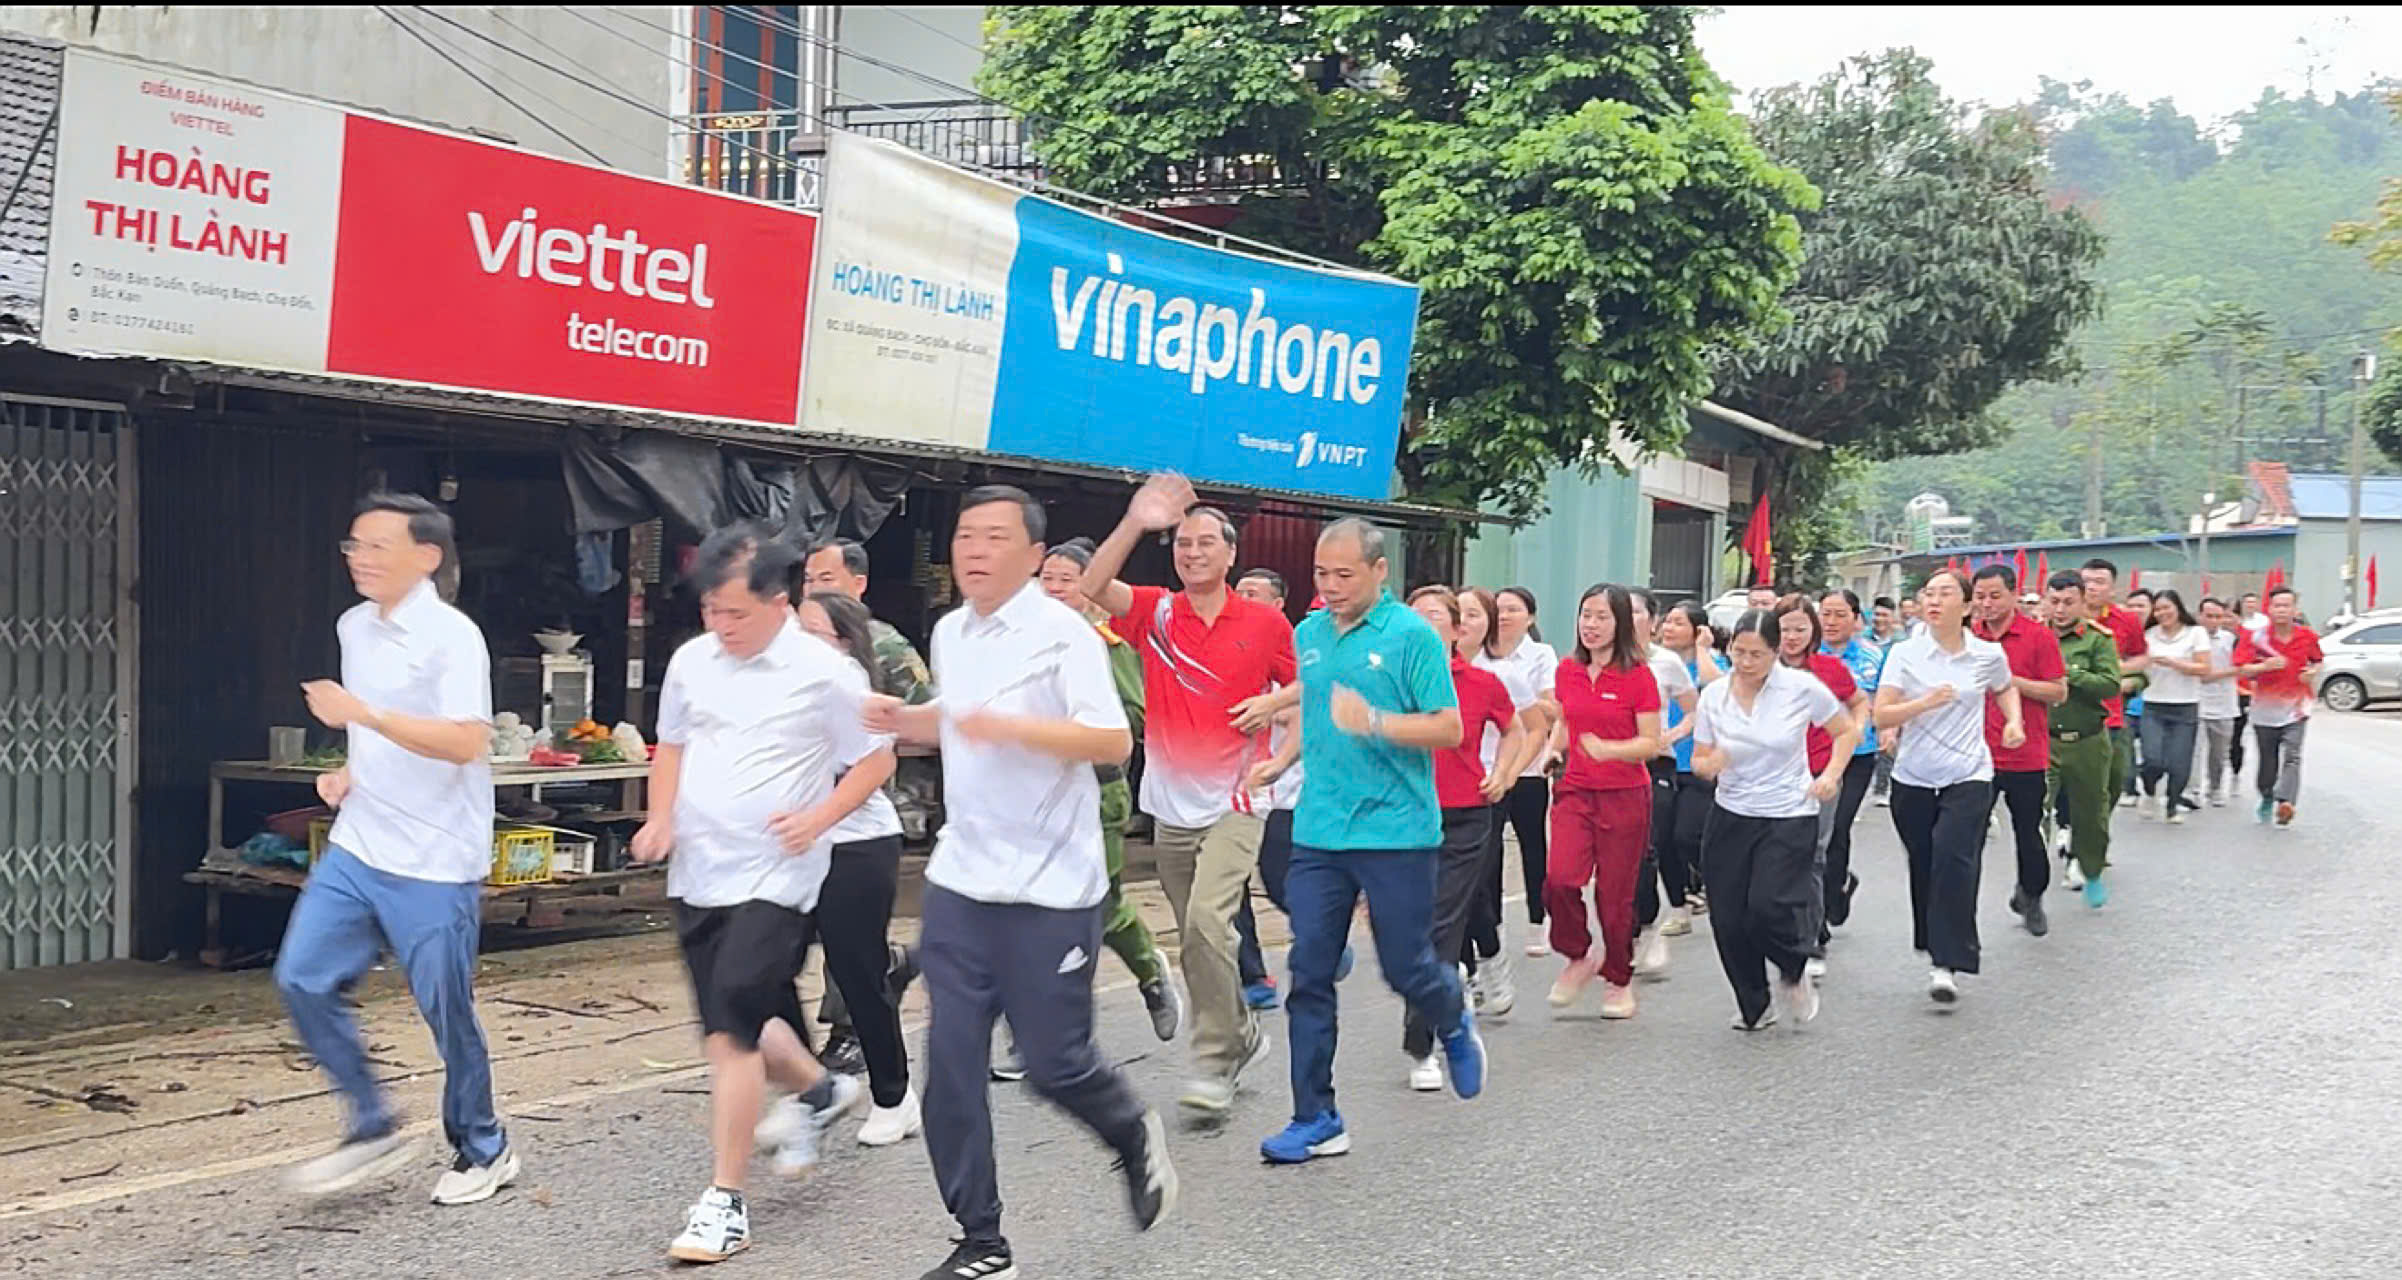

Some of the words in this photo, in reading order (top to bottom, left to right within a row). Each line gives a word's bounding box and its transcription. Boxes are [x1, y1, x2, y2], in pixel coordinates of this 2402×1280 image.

[169, 111, 235, 137] VIETTEL
[114, 145, 271, 205] HOÀNG
[86, 200, 159, 253] THỊ
[170, 208, 290, 265] LÀNH
[467, 206, 714, 309] viettel
[832, 260, 905, 304] HOÀNG
[909, 277, 942, 317] THỊ
[943, 280, 997, 322] LÀNH
[566, 311, 709, 368] telecom
[1051, 252, 1382, 405] vinaphone
[1317, 441, 1368, 468] VNPT
